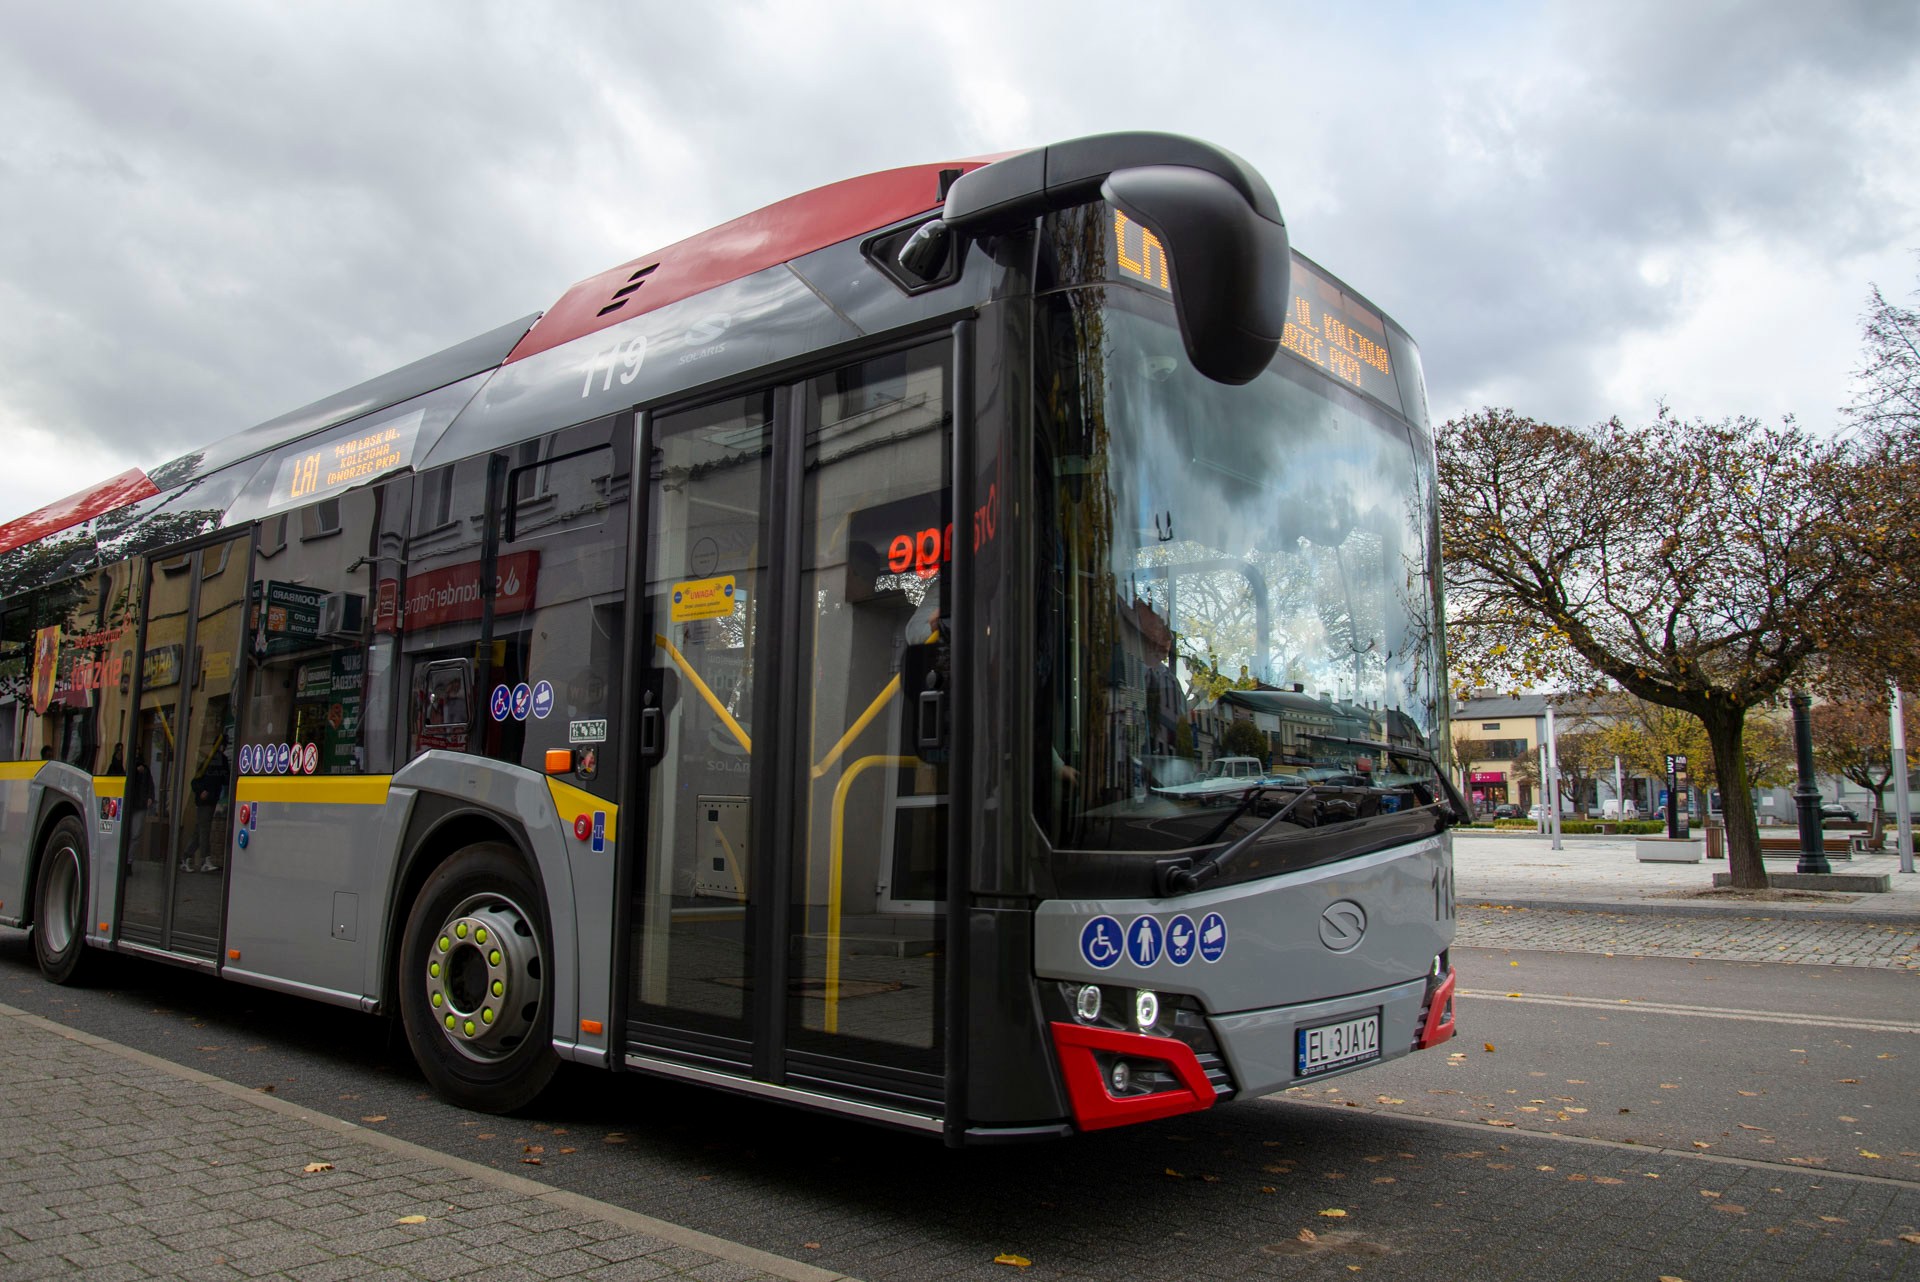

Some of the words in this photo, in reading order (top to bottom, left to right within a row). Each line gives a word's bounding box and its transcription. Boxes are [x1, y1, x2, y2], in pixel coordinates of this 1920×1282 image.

[580, 335, 648, 398] 119
[679, 342, 727, 366] SOLARIS
[1280, 322, 1325, 367] ORZEC
[1323, 313, 1389, 376] KOLEJOWA
[291, 452, 321, 498] ŁA1
[327, 460, 374, 486] (DWORZEC
[375, 451, 401, 470] PKP)
[340, 443, 390, 469] KOLEJOWA
[1309, 1031, 1329, 1063] EL
[1334, 1020, 1376, 1057] 3JA12
